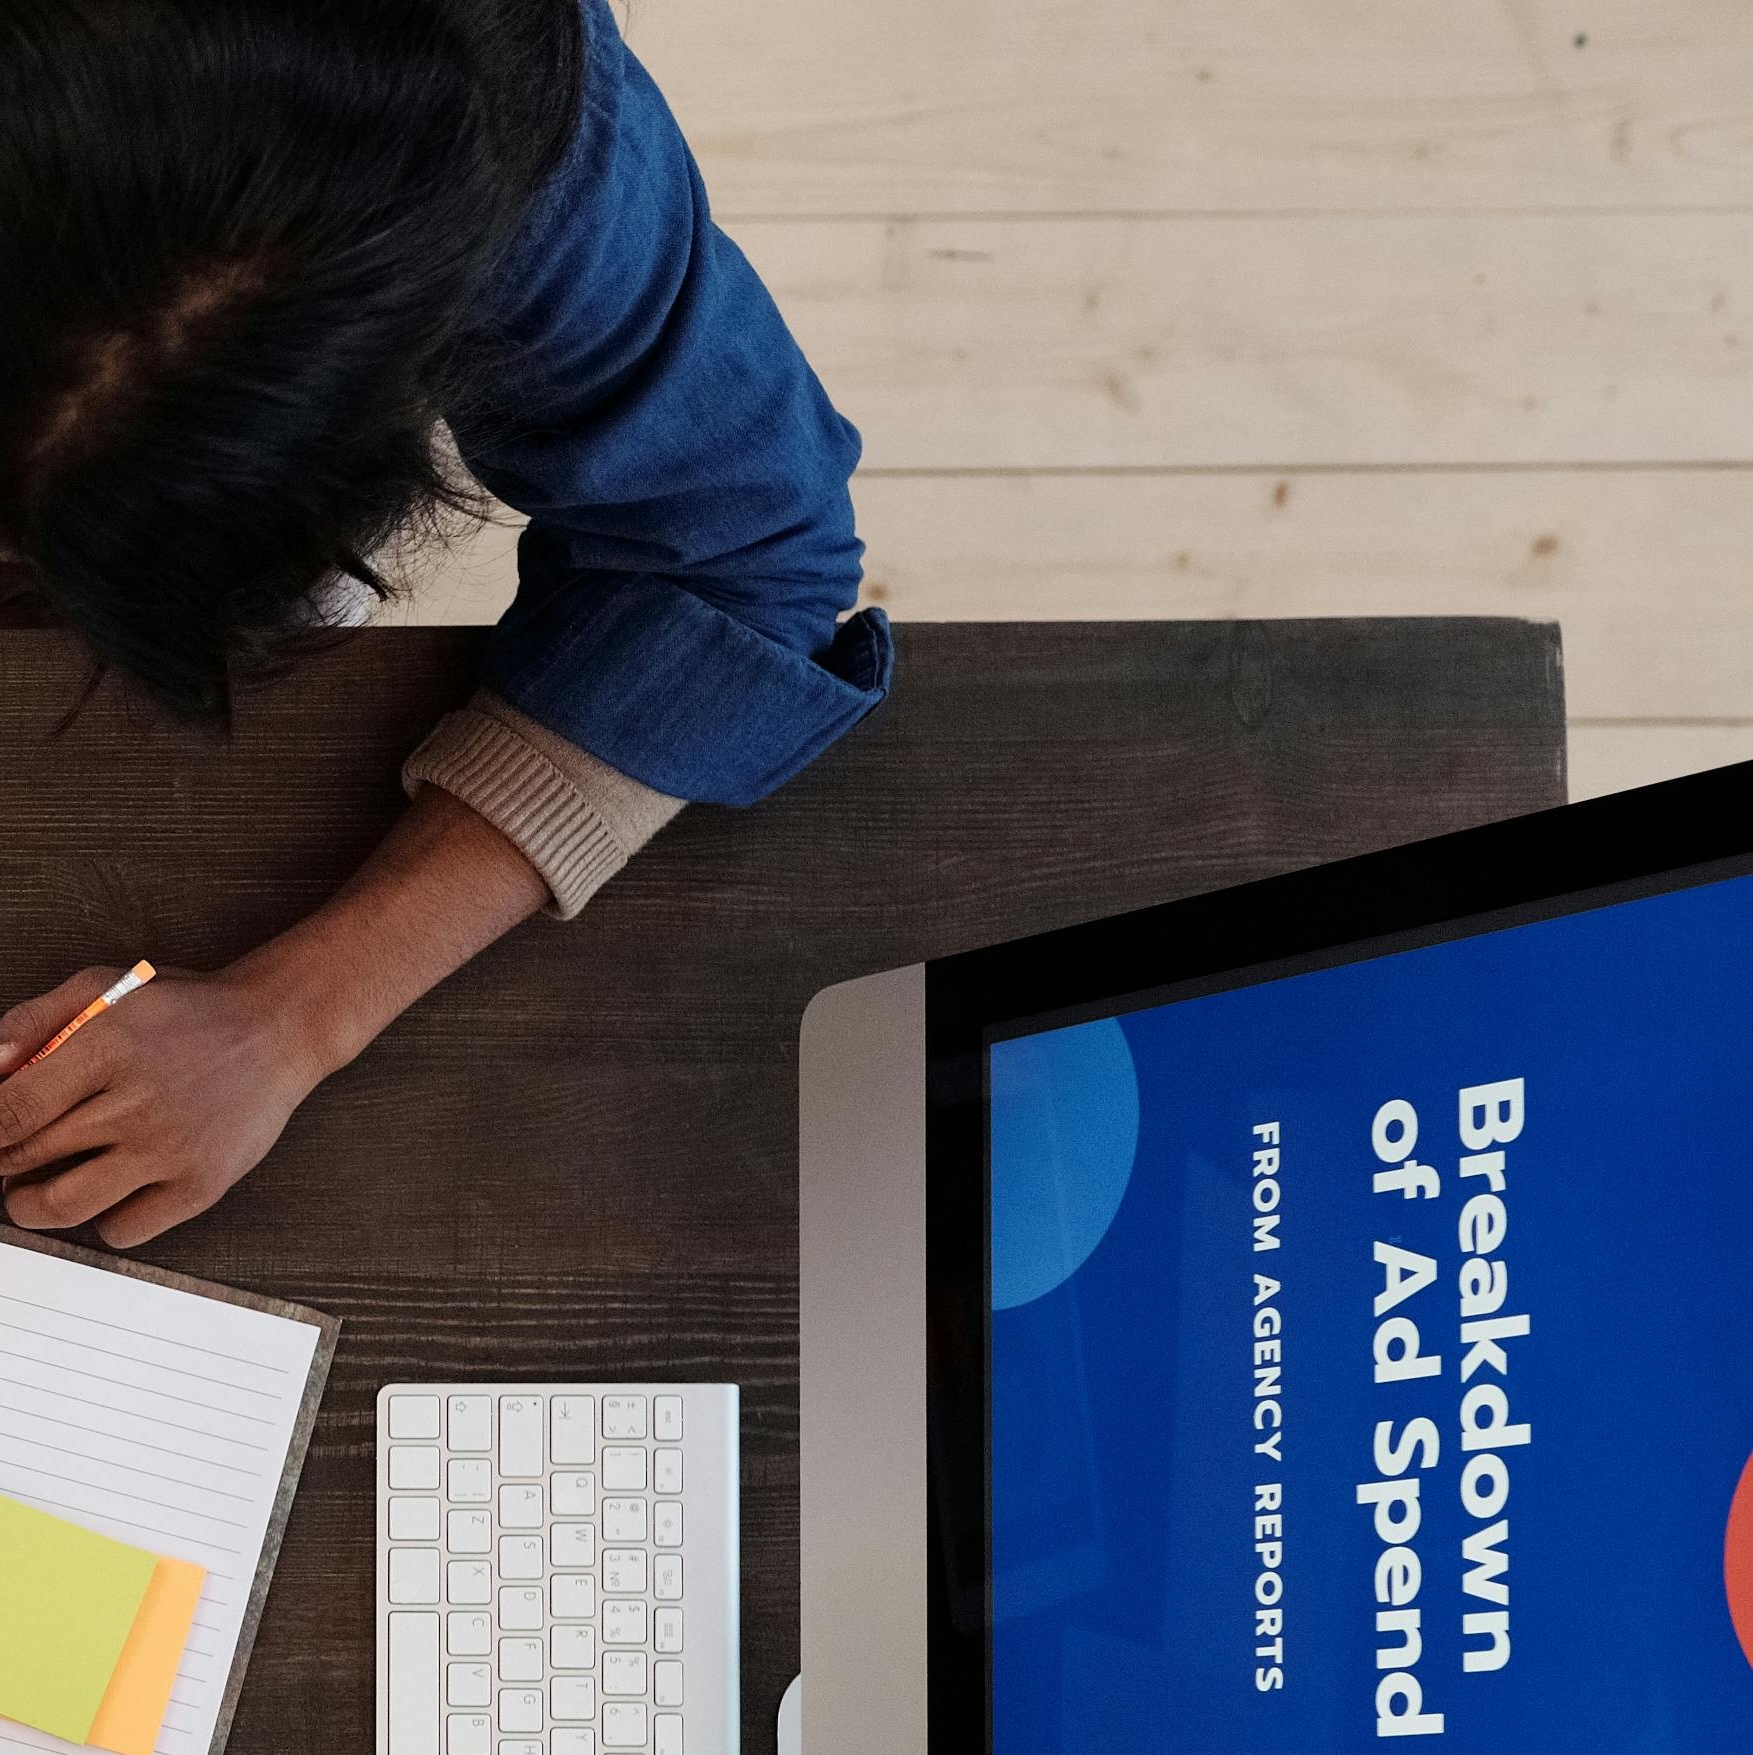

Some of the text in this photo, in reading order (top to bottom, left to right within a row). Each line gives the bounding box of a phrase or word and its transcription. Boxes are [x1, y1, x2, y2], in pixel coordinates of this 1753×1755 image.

[1253, 1122, 1283, 1691] FROM AGENCY REPORTS
[1357, 1100, 1444, 1737] of Ad Spend
[1459, 1078, 1531, 1672] Breakdown
